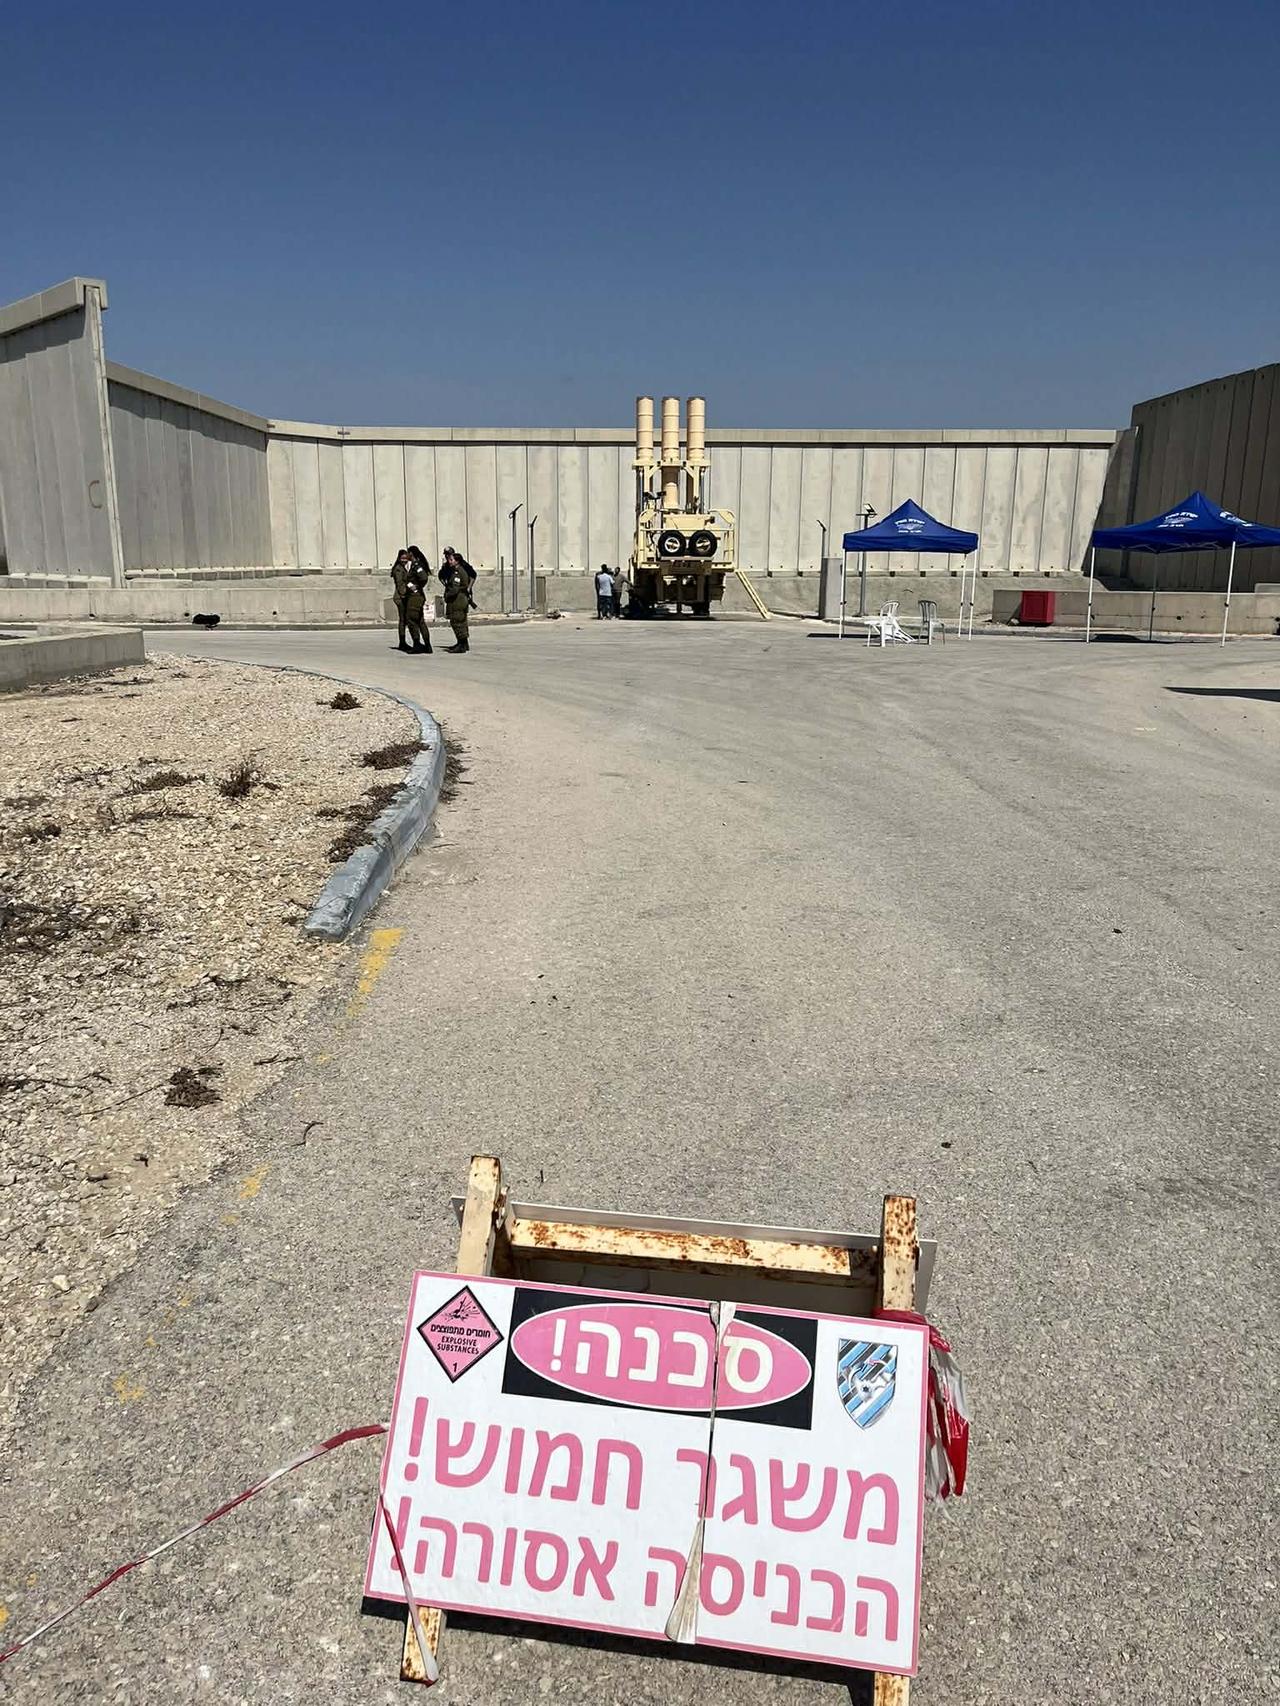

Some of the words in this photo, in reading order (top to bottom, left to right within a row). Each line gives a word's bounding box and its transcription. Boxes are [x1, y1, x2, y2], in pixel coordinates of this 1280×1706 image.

[437, 1343, 480, 1355] SUBSTANCES
[441, 1335, 477, 1347] EXPLOSIVE
[452, 1362, 458, 1373] 1
[466, 1329, 491, 1338] חומרים
[550, 1318, 774, 1393] סכנה!
[404, 1397, 643, 1509] חמוש!
[676, 1448, 898, 1545] משגר
[390, 1496, 618, 1600] אסורה!
[643, 1546, 898, 1640] הכניסה
